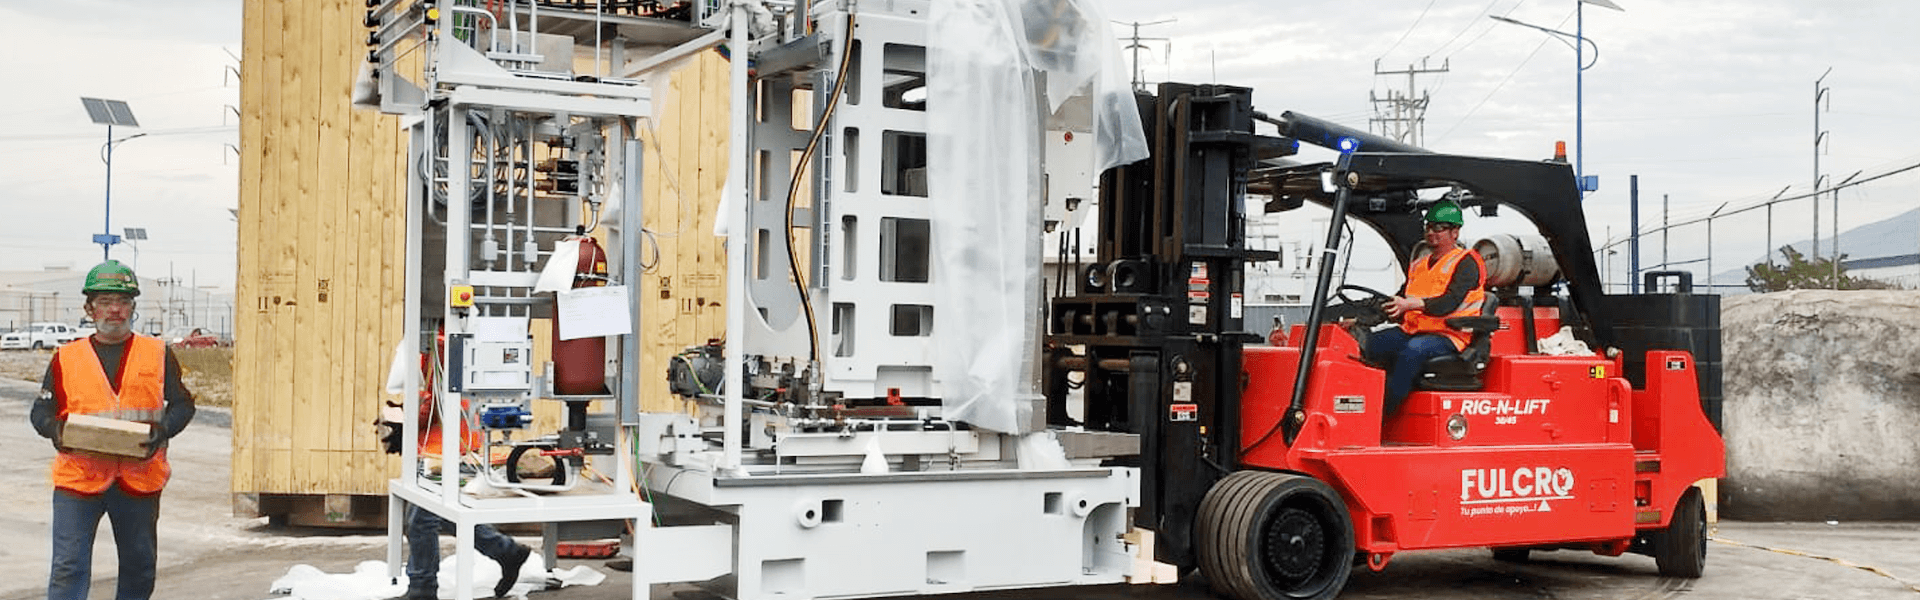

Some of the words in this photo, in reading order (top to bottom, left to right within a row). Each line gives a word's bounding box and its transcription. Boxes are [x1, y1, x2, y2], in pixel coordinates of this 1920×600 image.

[1460, 399, 1550, 415] RIG-N-LIFT
[1460, 467, 1575, 500] FULCRO
[1494, 504, 1504, 514] de
